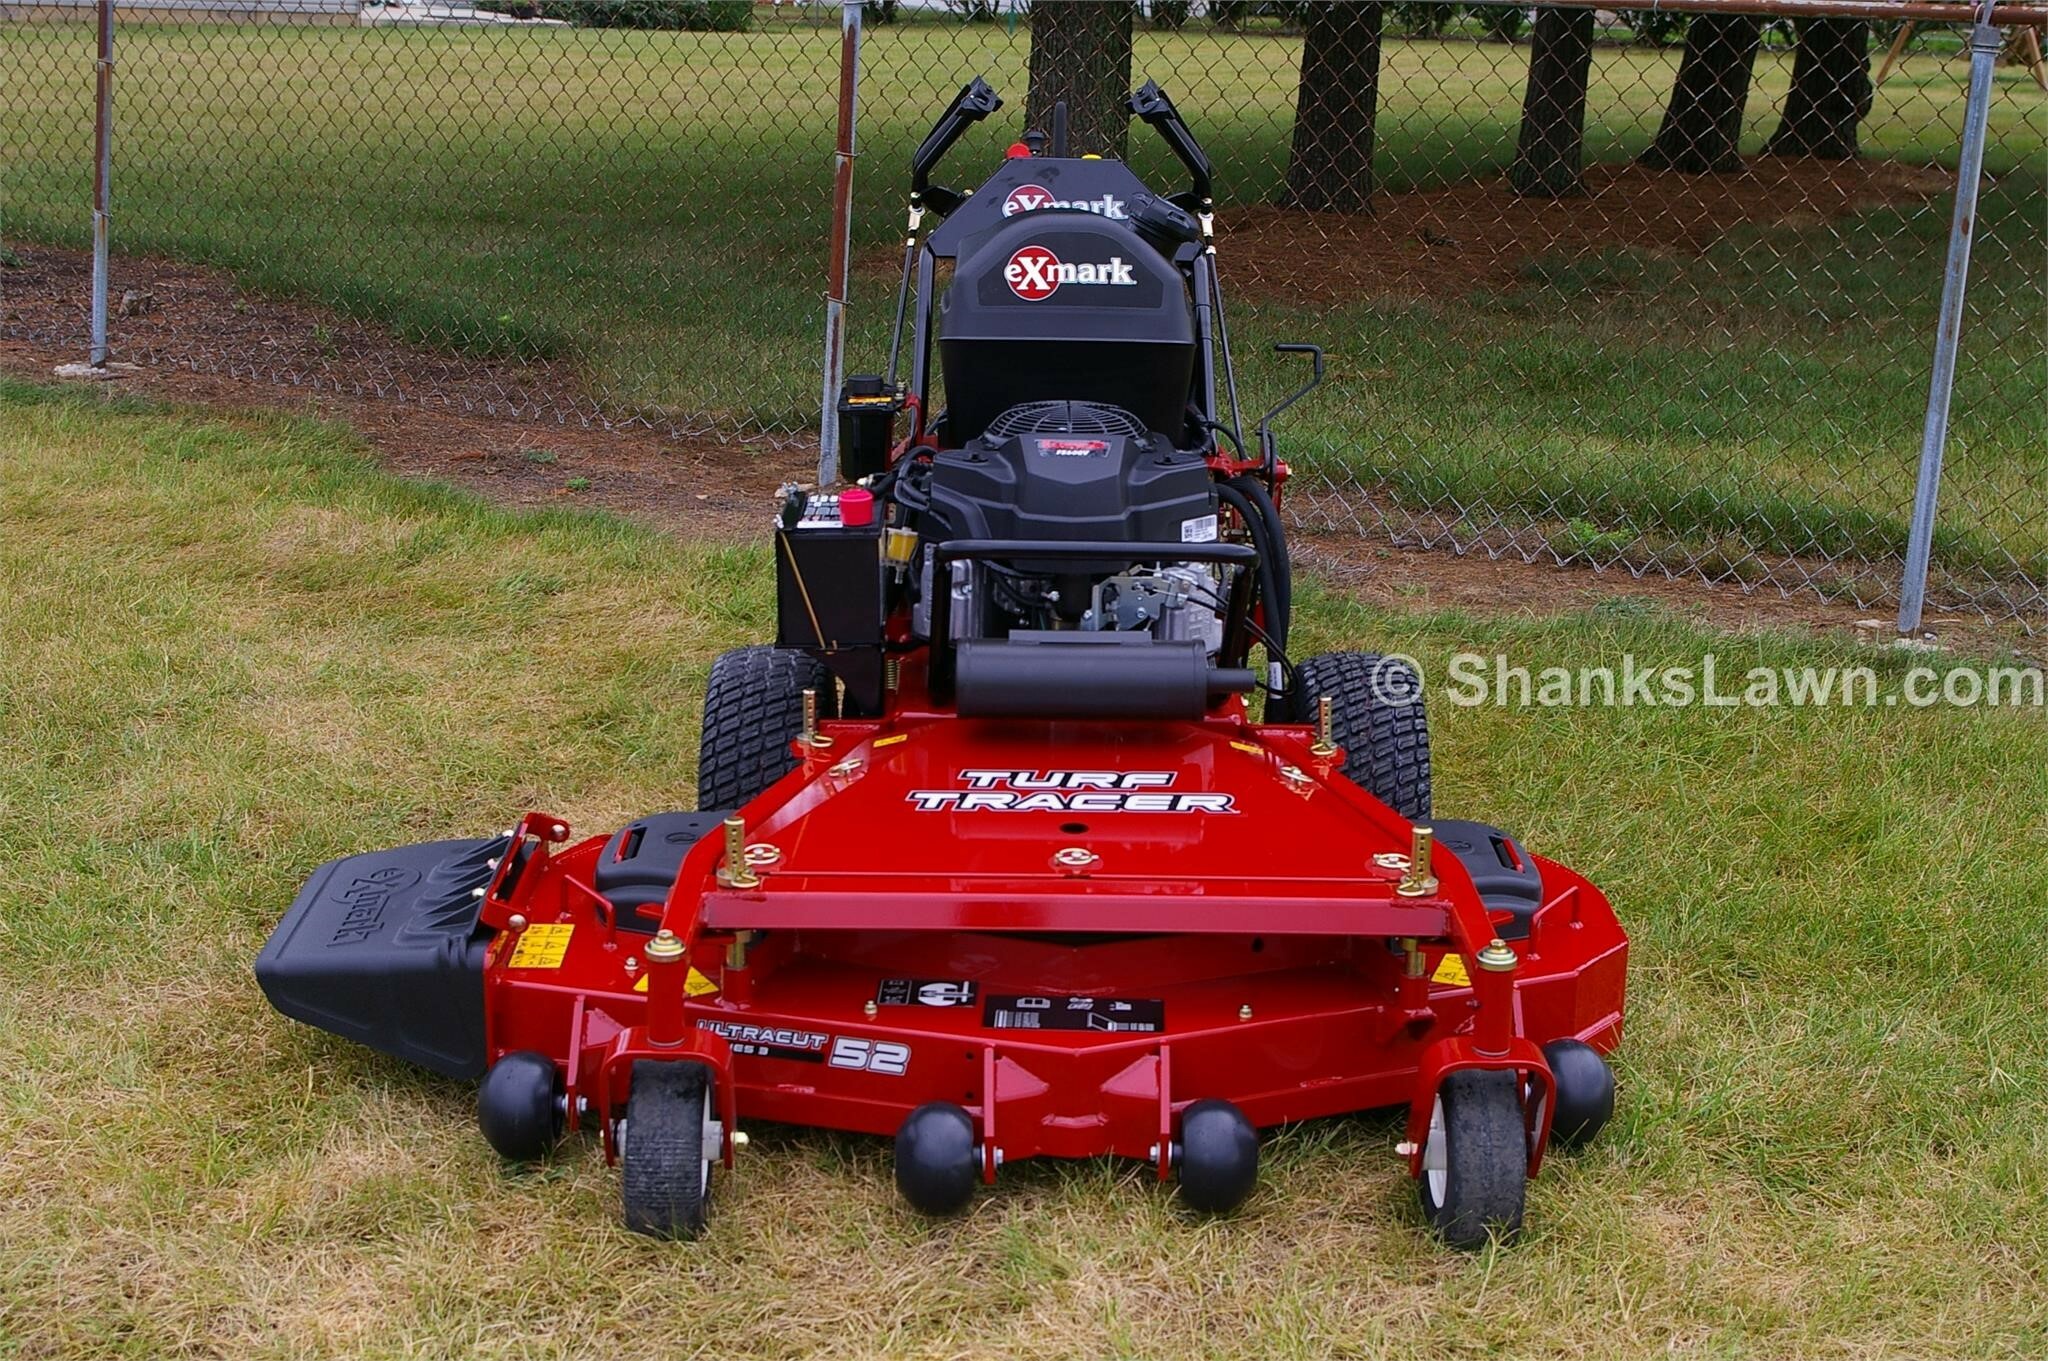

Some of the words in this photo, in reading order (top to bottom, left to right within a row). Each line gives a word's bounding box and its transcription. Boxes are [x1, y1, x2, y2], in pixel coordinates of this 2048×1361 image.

[958, 769, 1177, 790] TURF
[905, 791, 1240, 813] TRACER
[829, 1036, 911, 1076] 52
